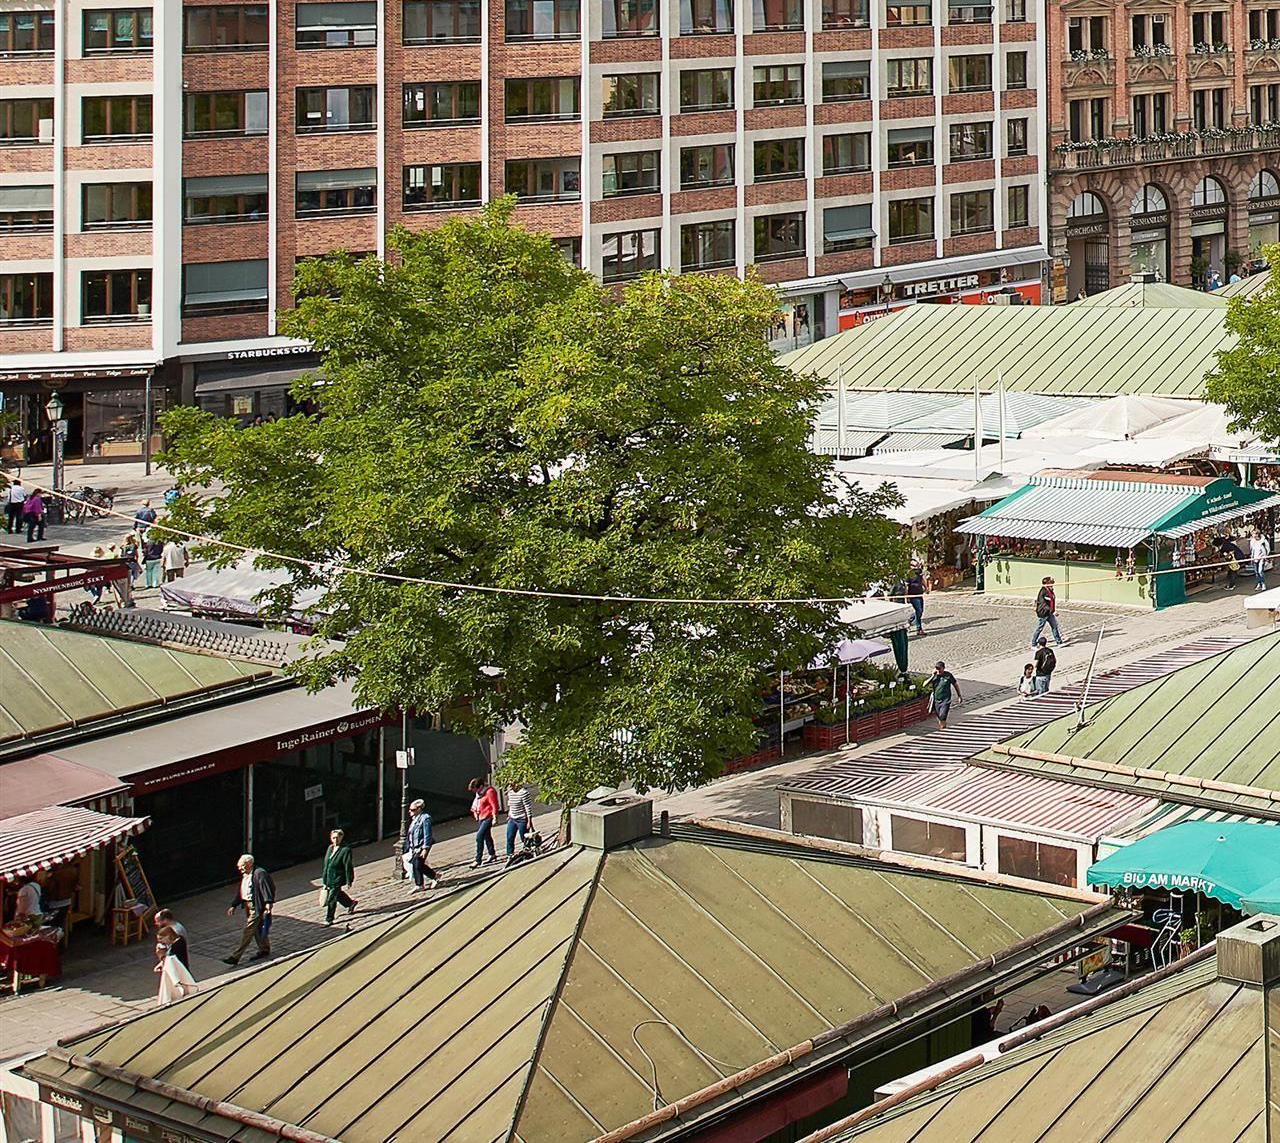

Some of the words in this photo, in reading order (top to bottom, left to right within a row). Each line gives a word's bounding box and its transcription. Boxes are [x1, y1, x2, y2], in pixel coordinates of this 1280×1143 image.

[904, 274, 979, 296] TRETTER
[227, 347, 291, 359] STARBUCKS
[292, 344, 331, 354] COF
[33, 578, 85, 595] NYMPHENBURG
[87, 575, 104, 584] SEKT
[276, 738, 299, 750] Inge
[300, 728, 335, 743] Rainer
[350, 716, 382, 730] BLUMEN
[1123, 872, 1146, 884] BIO
[1147, 873, 1168, 885] AM
[1171, 874, 1216, 894] MARKT
